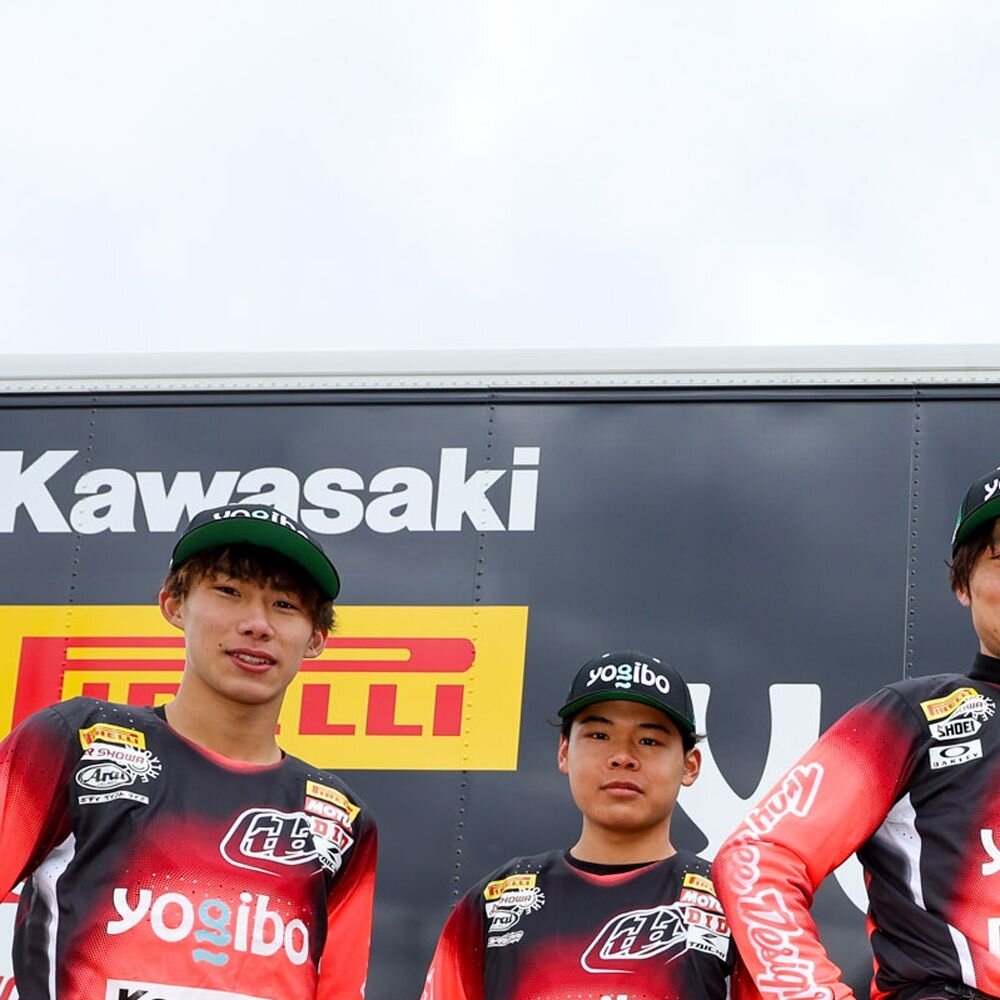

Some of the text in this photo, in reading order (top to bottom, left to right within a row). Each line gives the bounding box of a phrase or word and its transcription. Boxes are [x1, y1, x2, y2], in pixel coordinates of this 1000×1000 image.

[0, 447, 540, 533] Kawasaki
[587, 662, 670, 694] yogibo
[937, 721, 976, 738] SHOEI
[107, 887, 310, 966] yogibo
